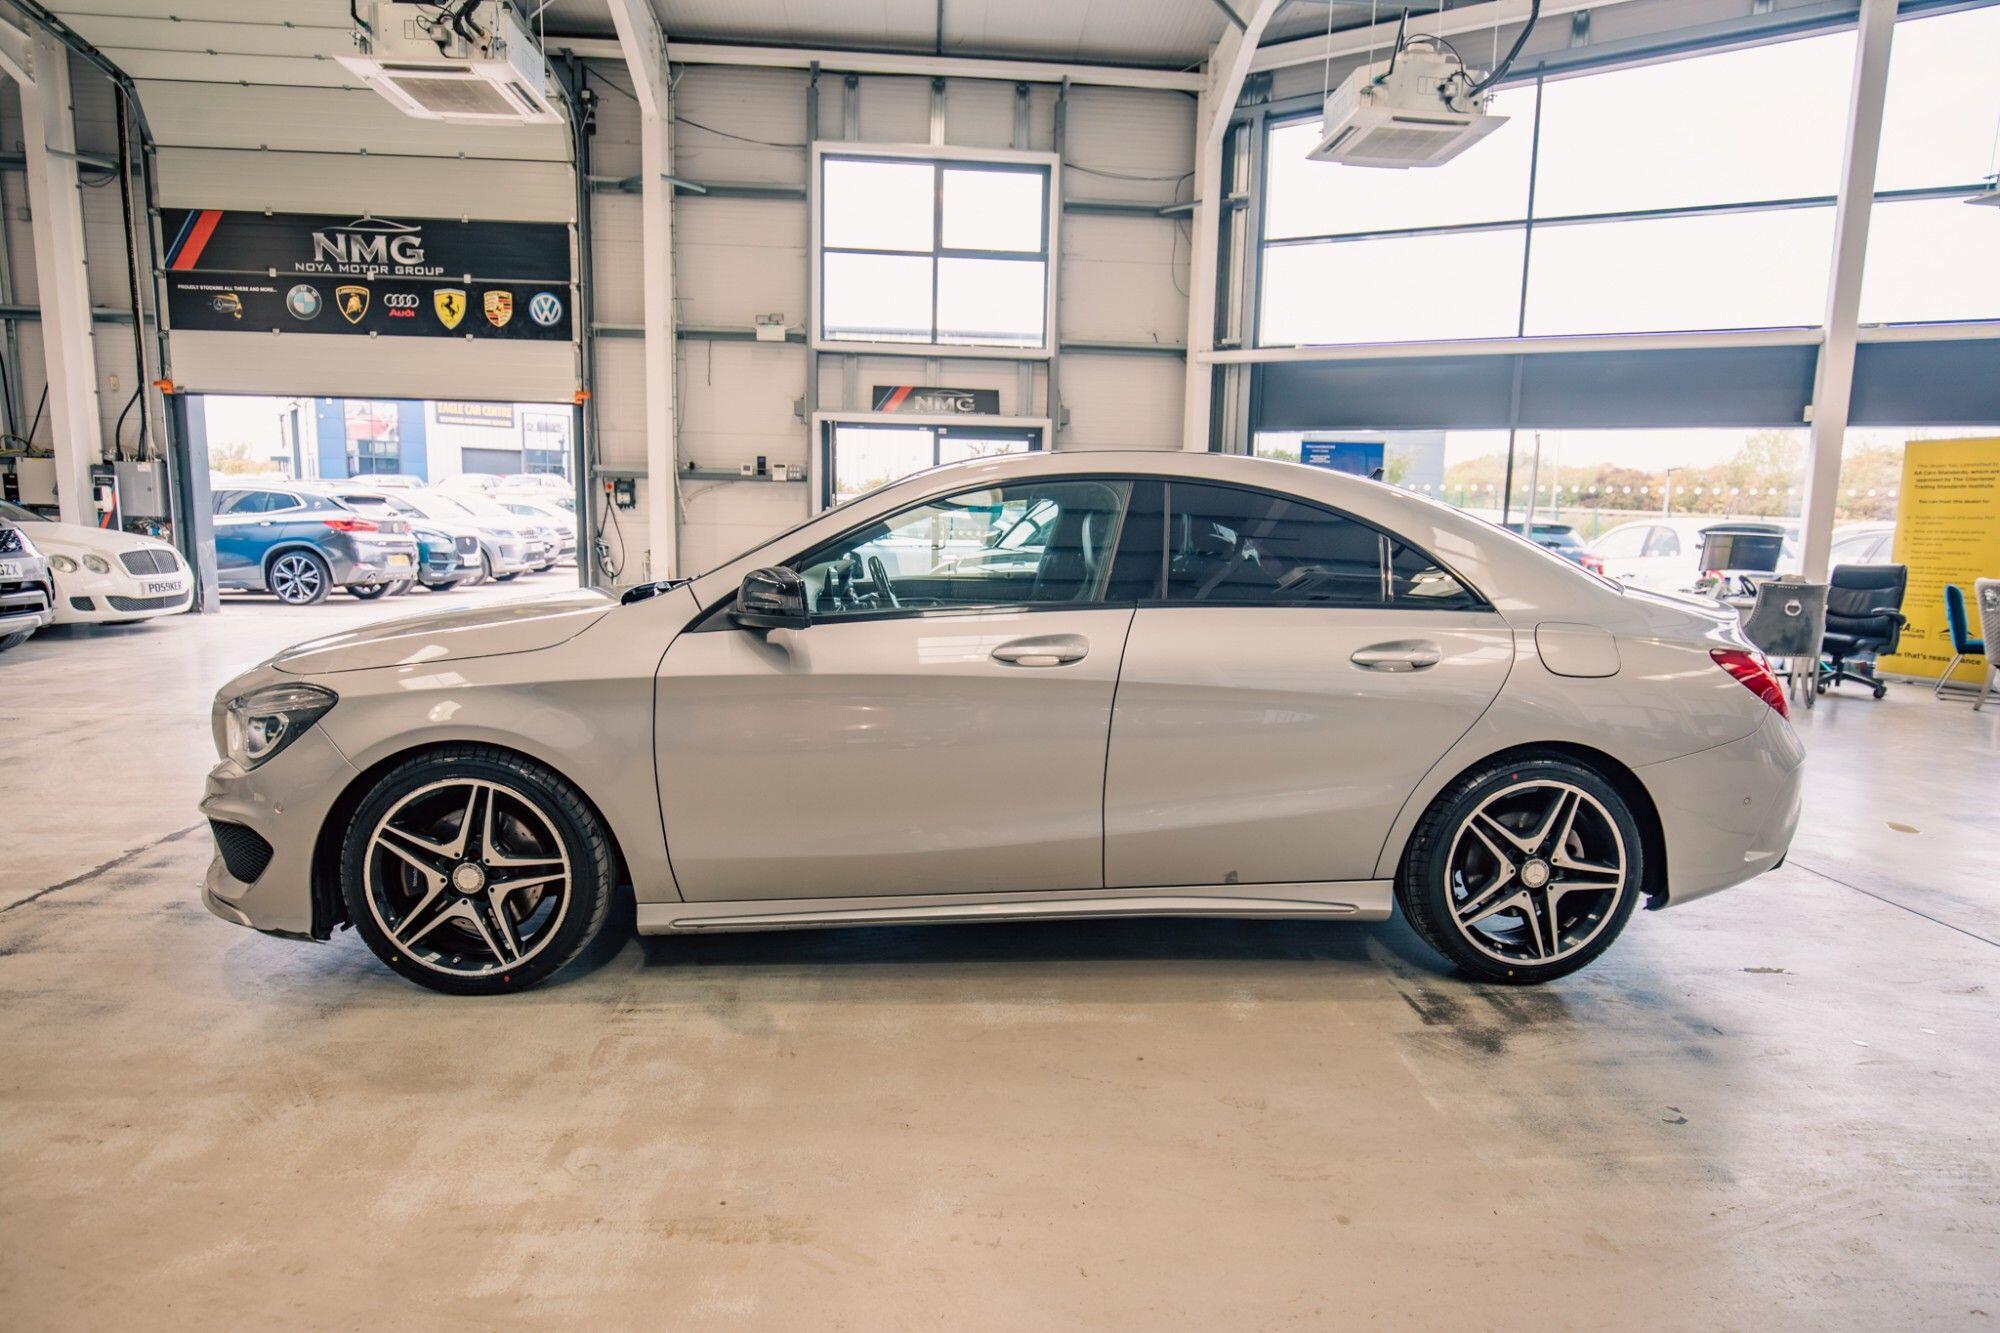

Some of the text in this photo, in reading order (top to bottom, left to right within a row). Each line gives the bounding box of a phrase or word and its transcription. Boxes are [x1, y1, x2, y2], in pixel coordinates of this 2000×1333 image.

[312, 231, 425, 265] NMG
[295, 262, 445, 276] NOYA MOTOR GROUP
[389, 308, 415, 318] Audi
[438, 401, 513, 418] EAGLE CAR CENTRE
[914, 395, 976, 412] NMG
